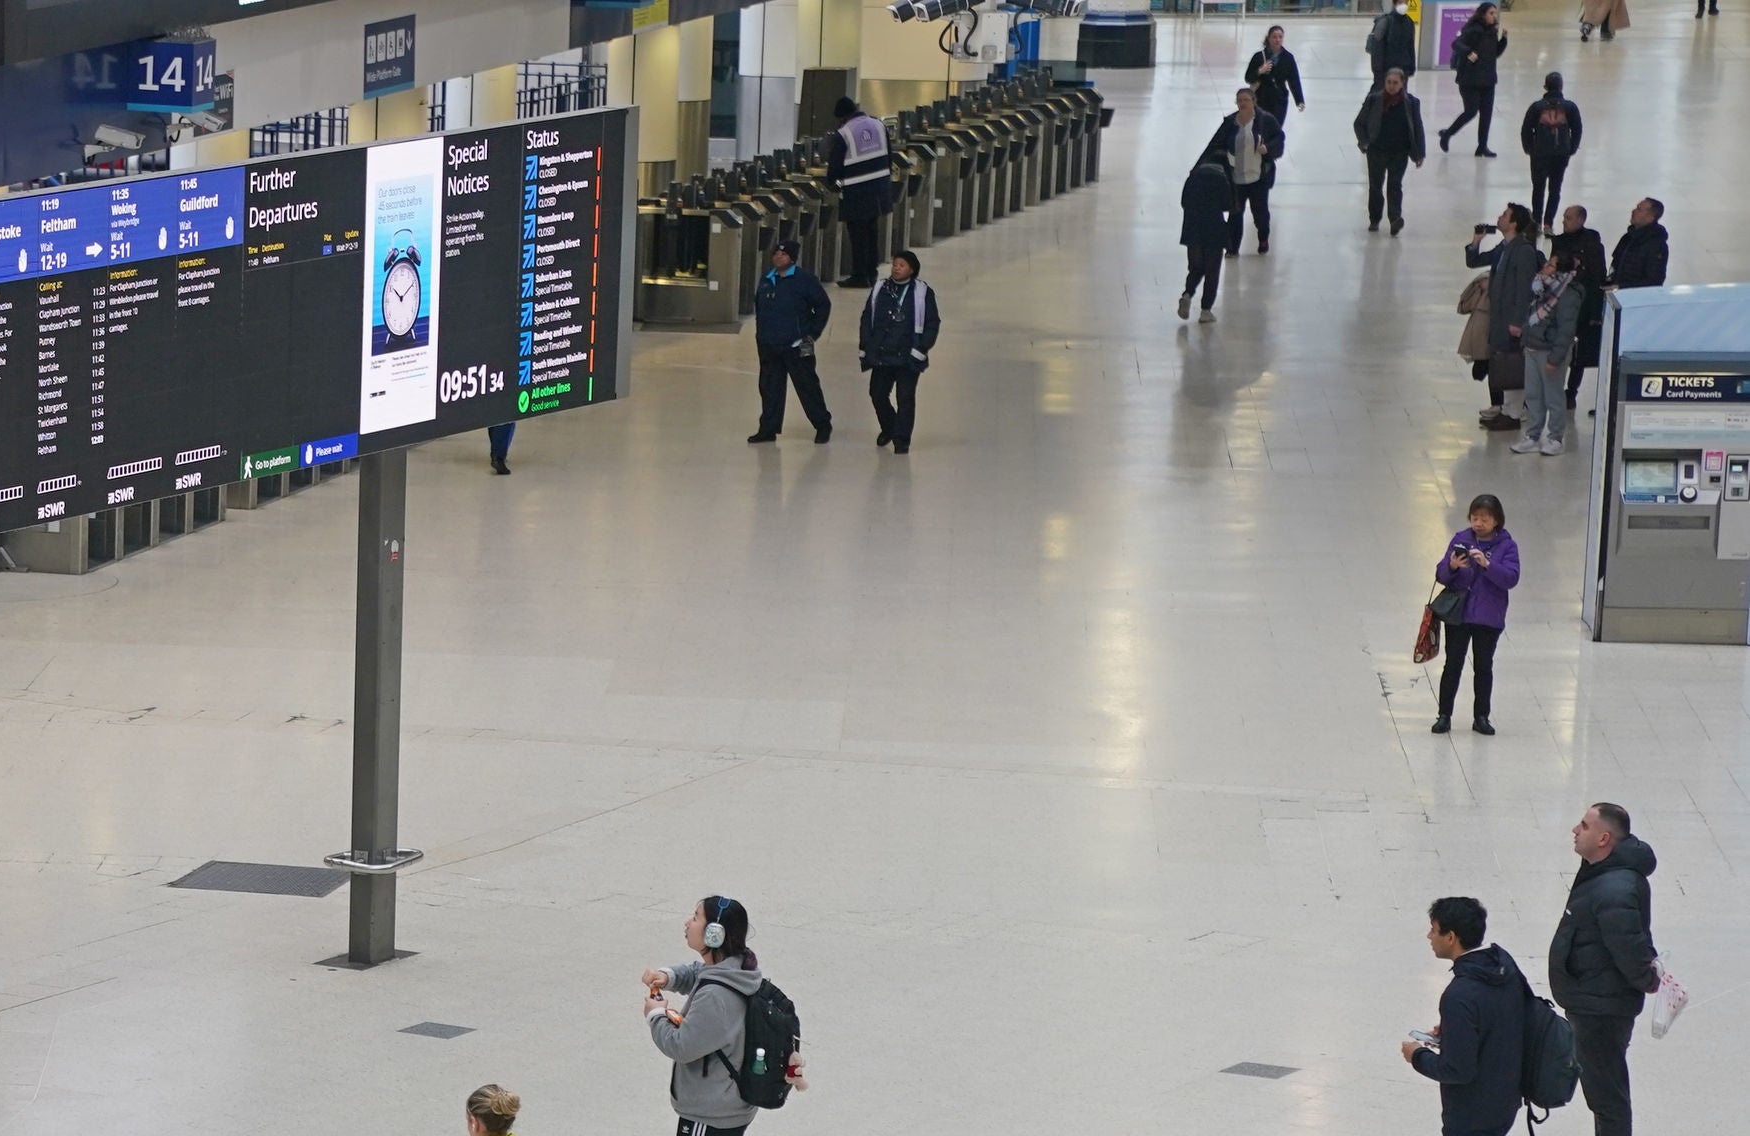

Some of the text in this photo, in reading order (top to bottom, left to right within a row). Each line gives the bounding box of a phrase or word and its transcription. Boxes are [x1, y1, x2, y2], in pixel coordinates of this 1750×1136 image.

[138, 55, 186, 92] 14
[195, 55, 213, 92] 14
[527, 130, 559, 150] Status
[448, 139, 488, 170] Special
[180, 178, 197, 190] 11:45
[250, 168, 296, 194] Further
[447, 173, 490, 197] Notices
[112, 188, 129, 201] 11:35
[180, 194, 218, 212] Guildford
[41, 199, 59, 211] 11:19
[111, 202, 137, 217] Woking
[249, 201, 318, 231] Departures
[41, 217, 77, 234] Feltham
[179, 232, 199, 249] 5-11
[110, 242, 131, 260] 5-11
[40, 253, 67, 271] 12-19
[440, 364, 504, 403] 09:51 34
[1667, 377, 1715, 388] TICKETS
[1666, 390, 1722, 400] Card Payments
[316, 443, 343, 457] Please wait
[255, 455, 291, 470] Go to platform
